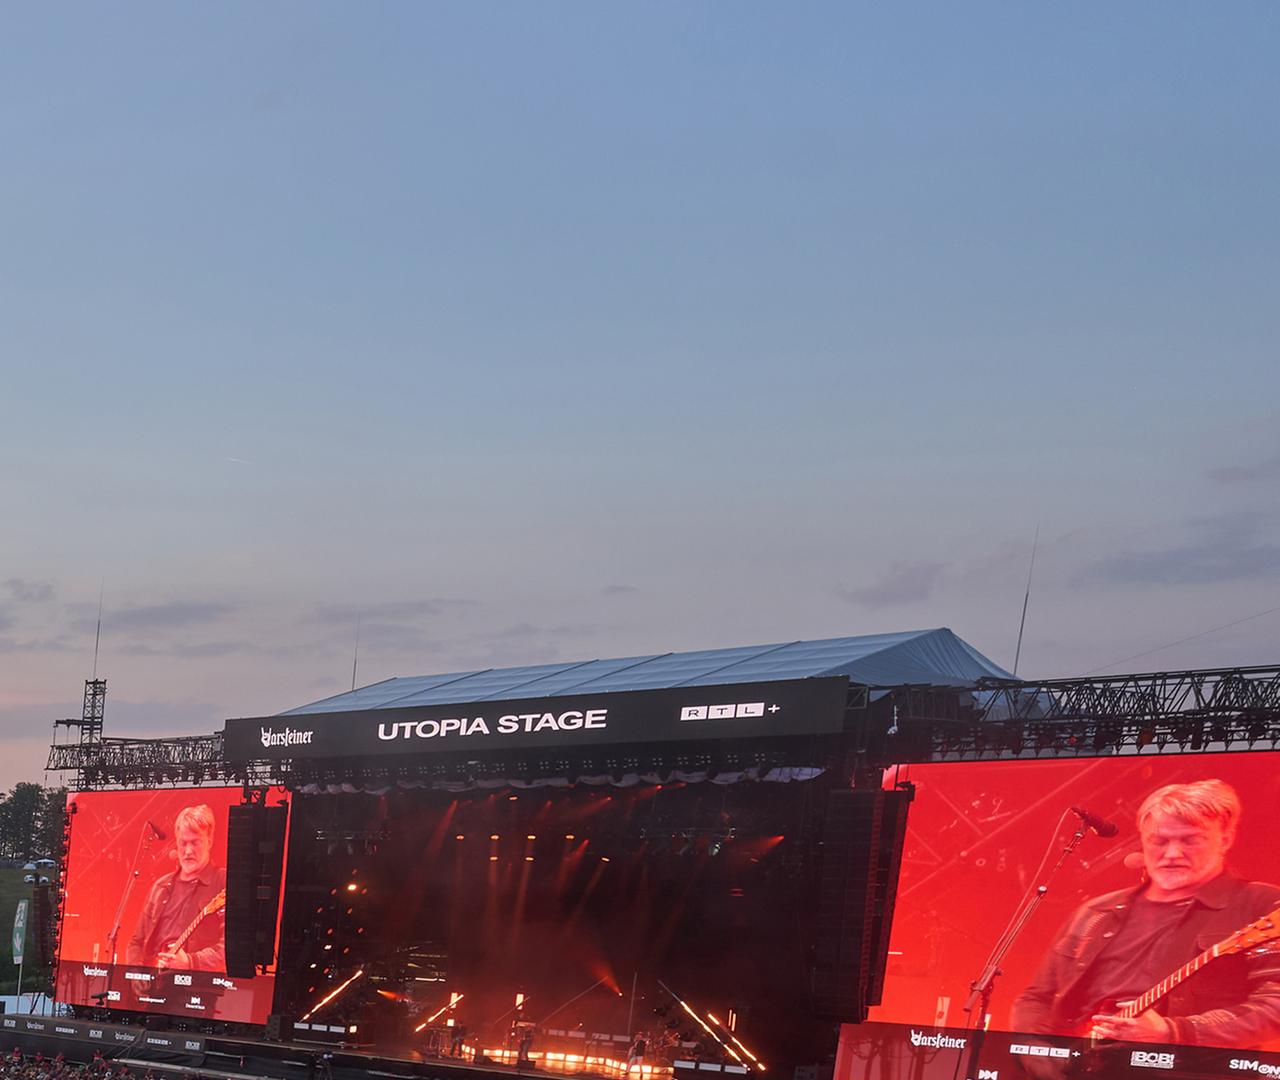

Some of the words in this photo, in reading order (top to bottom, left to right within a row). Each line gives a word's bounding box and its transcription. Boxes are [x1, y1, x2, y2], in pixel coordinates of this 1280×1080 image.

[681, 703, 780, 720] RTL+
[378, 717, 489, 740] UTOPIA
[497, 709, 608, 733] STAGE
[260, 727, 313, 747] Warsteiner
[910, 1029, 967, 1049] Warsteiner
